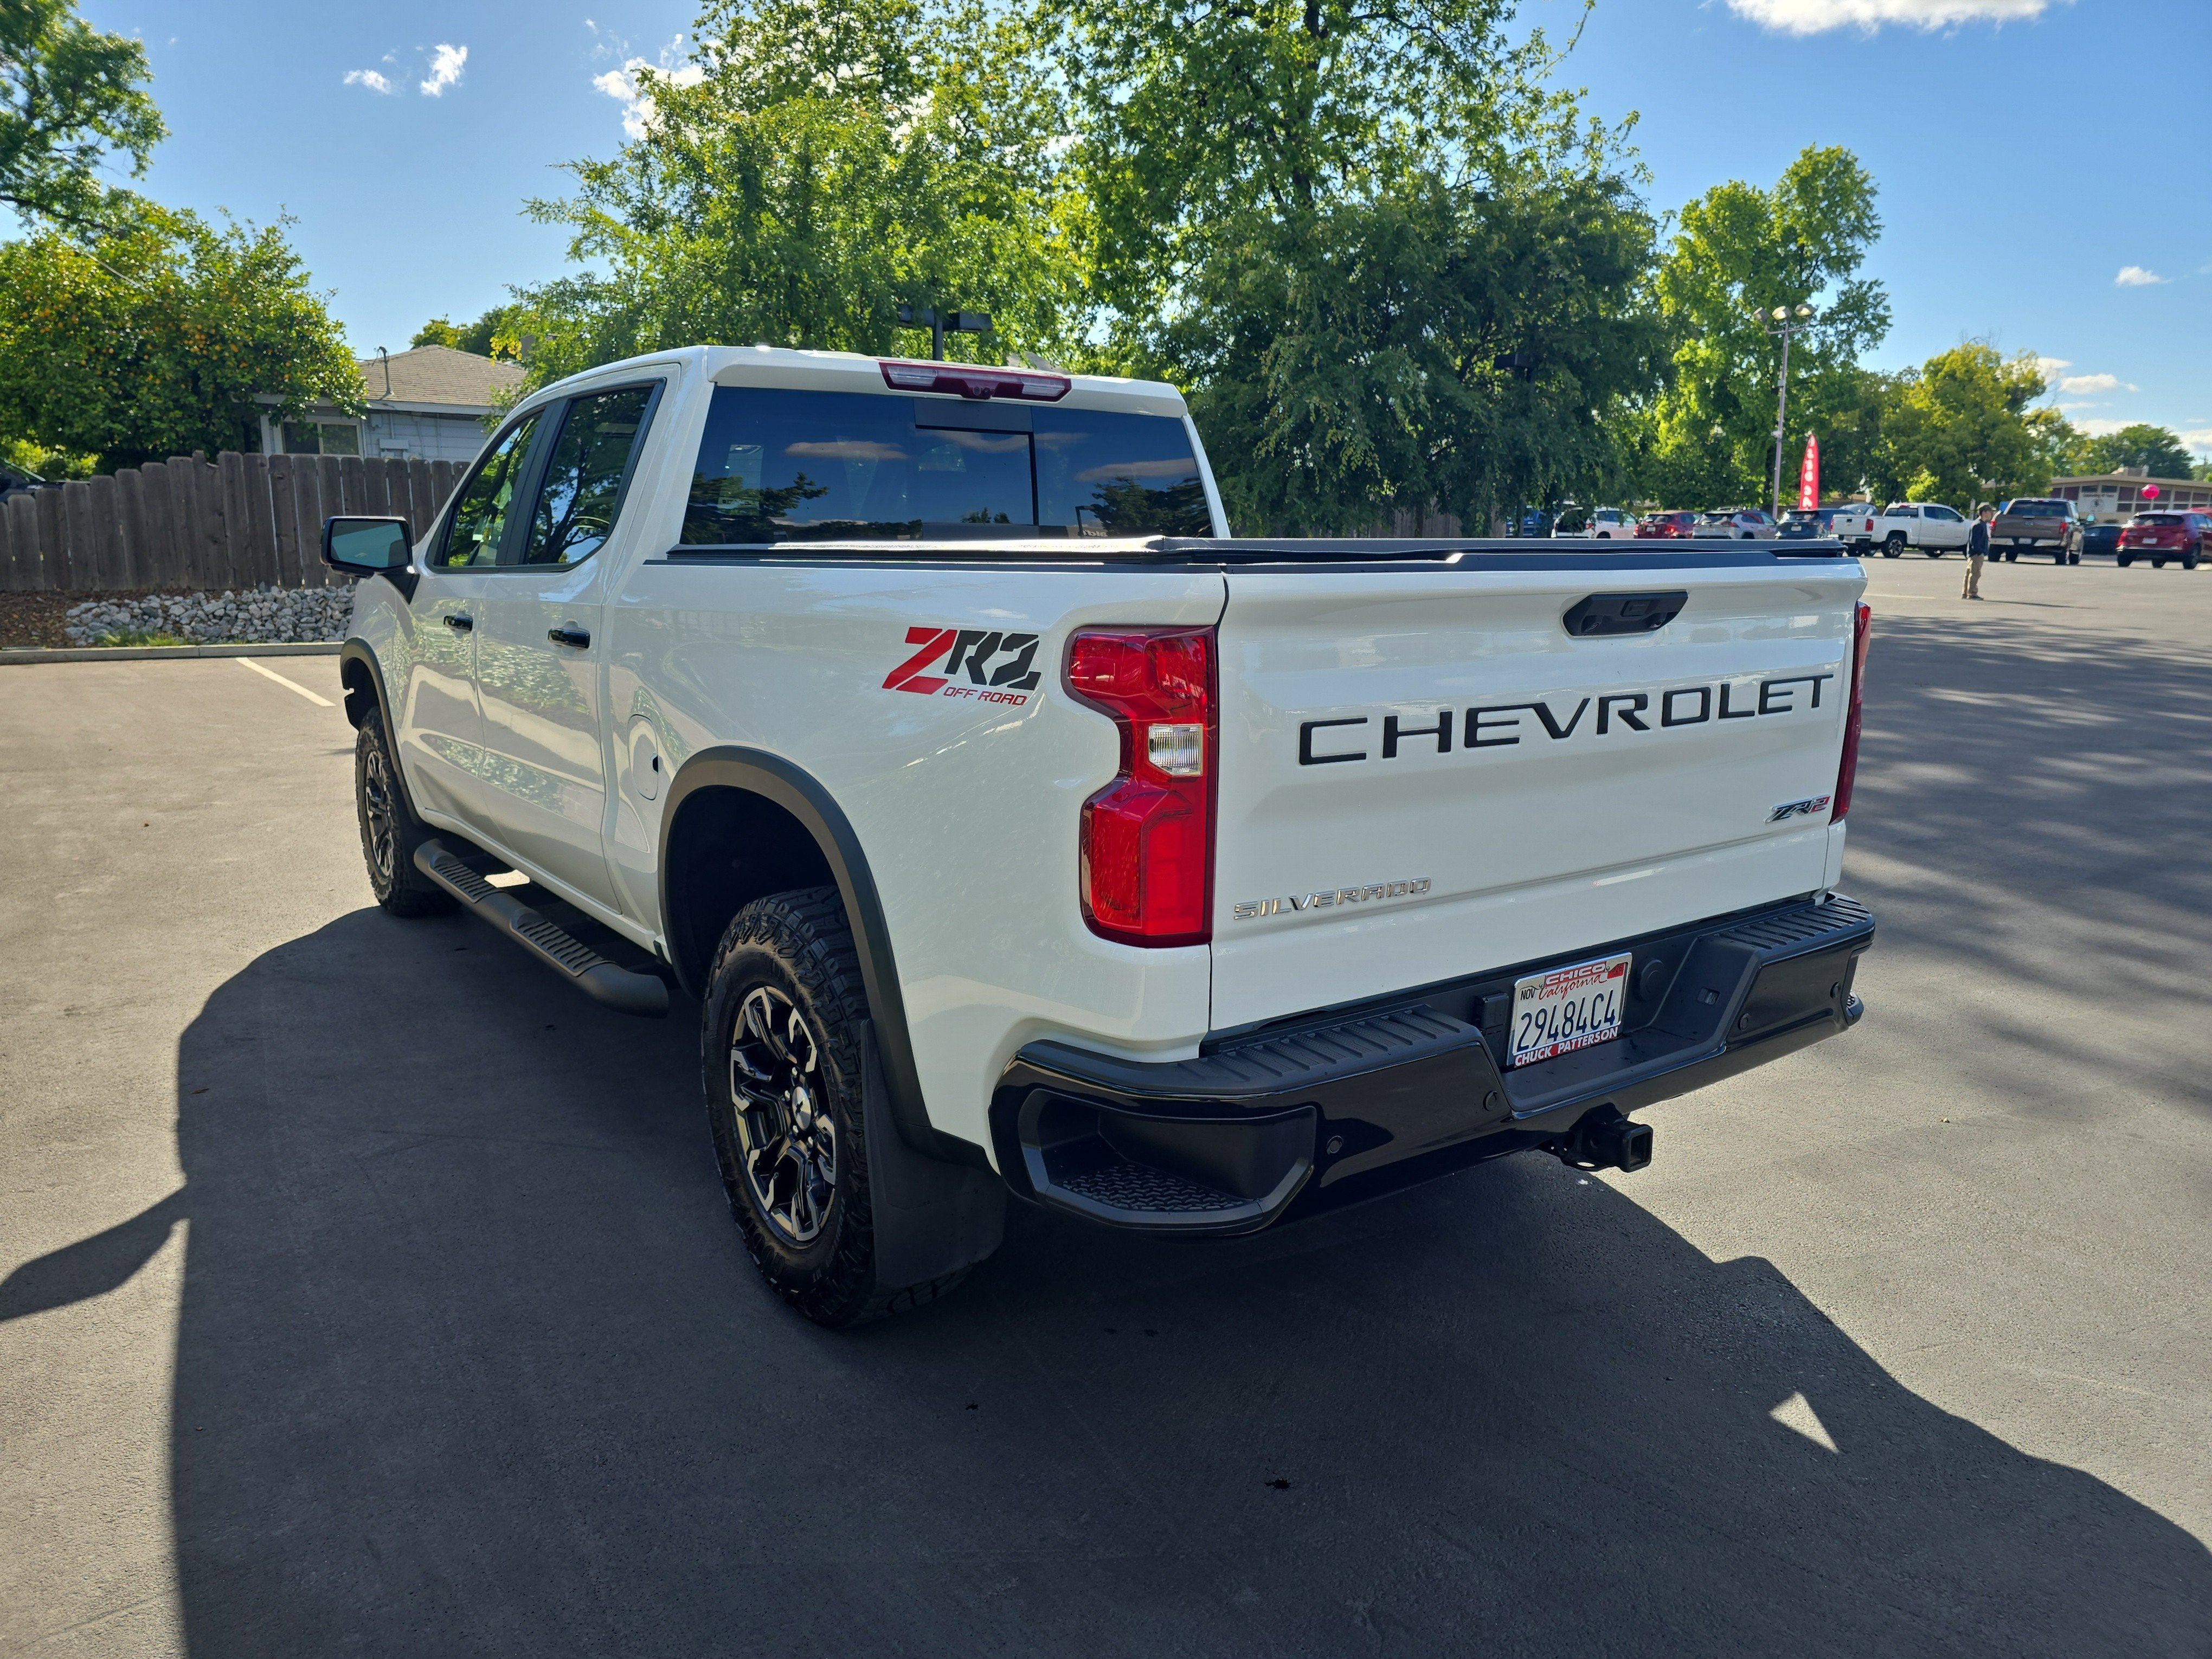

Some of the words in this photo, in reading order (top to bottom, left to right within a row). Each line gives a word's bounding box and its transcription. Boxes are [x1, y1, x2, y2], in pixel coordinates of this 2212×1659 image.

[882, 627, 1041, 695] ZR2
[943, 687, 978, 698] OFF
[978, 691, 1027, 705] ROAD
[1300, 674, 1834, 765] CHEVROLET
[1763, 794, 1831, 824] ZR2
[1234, 877, 1432, 920] SILVERADO
[1539, 974, 1607, 1000] California
[1546, 963, 1606, 984] CHICO
[1520, 988, 1535, 1000] NOV
[1517, 989, 1615, 1052] 29484C4
[1515, 1046, 1552, 1066] CHUCK
[1558, 1027, 1618, 1053] PATTERSON
